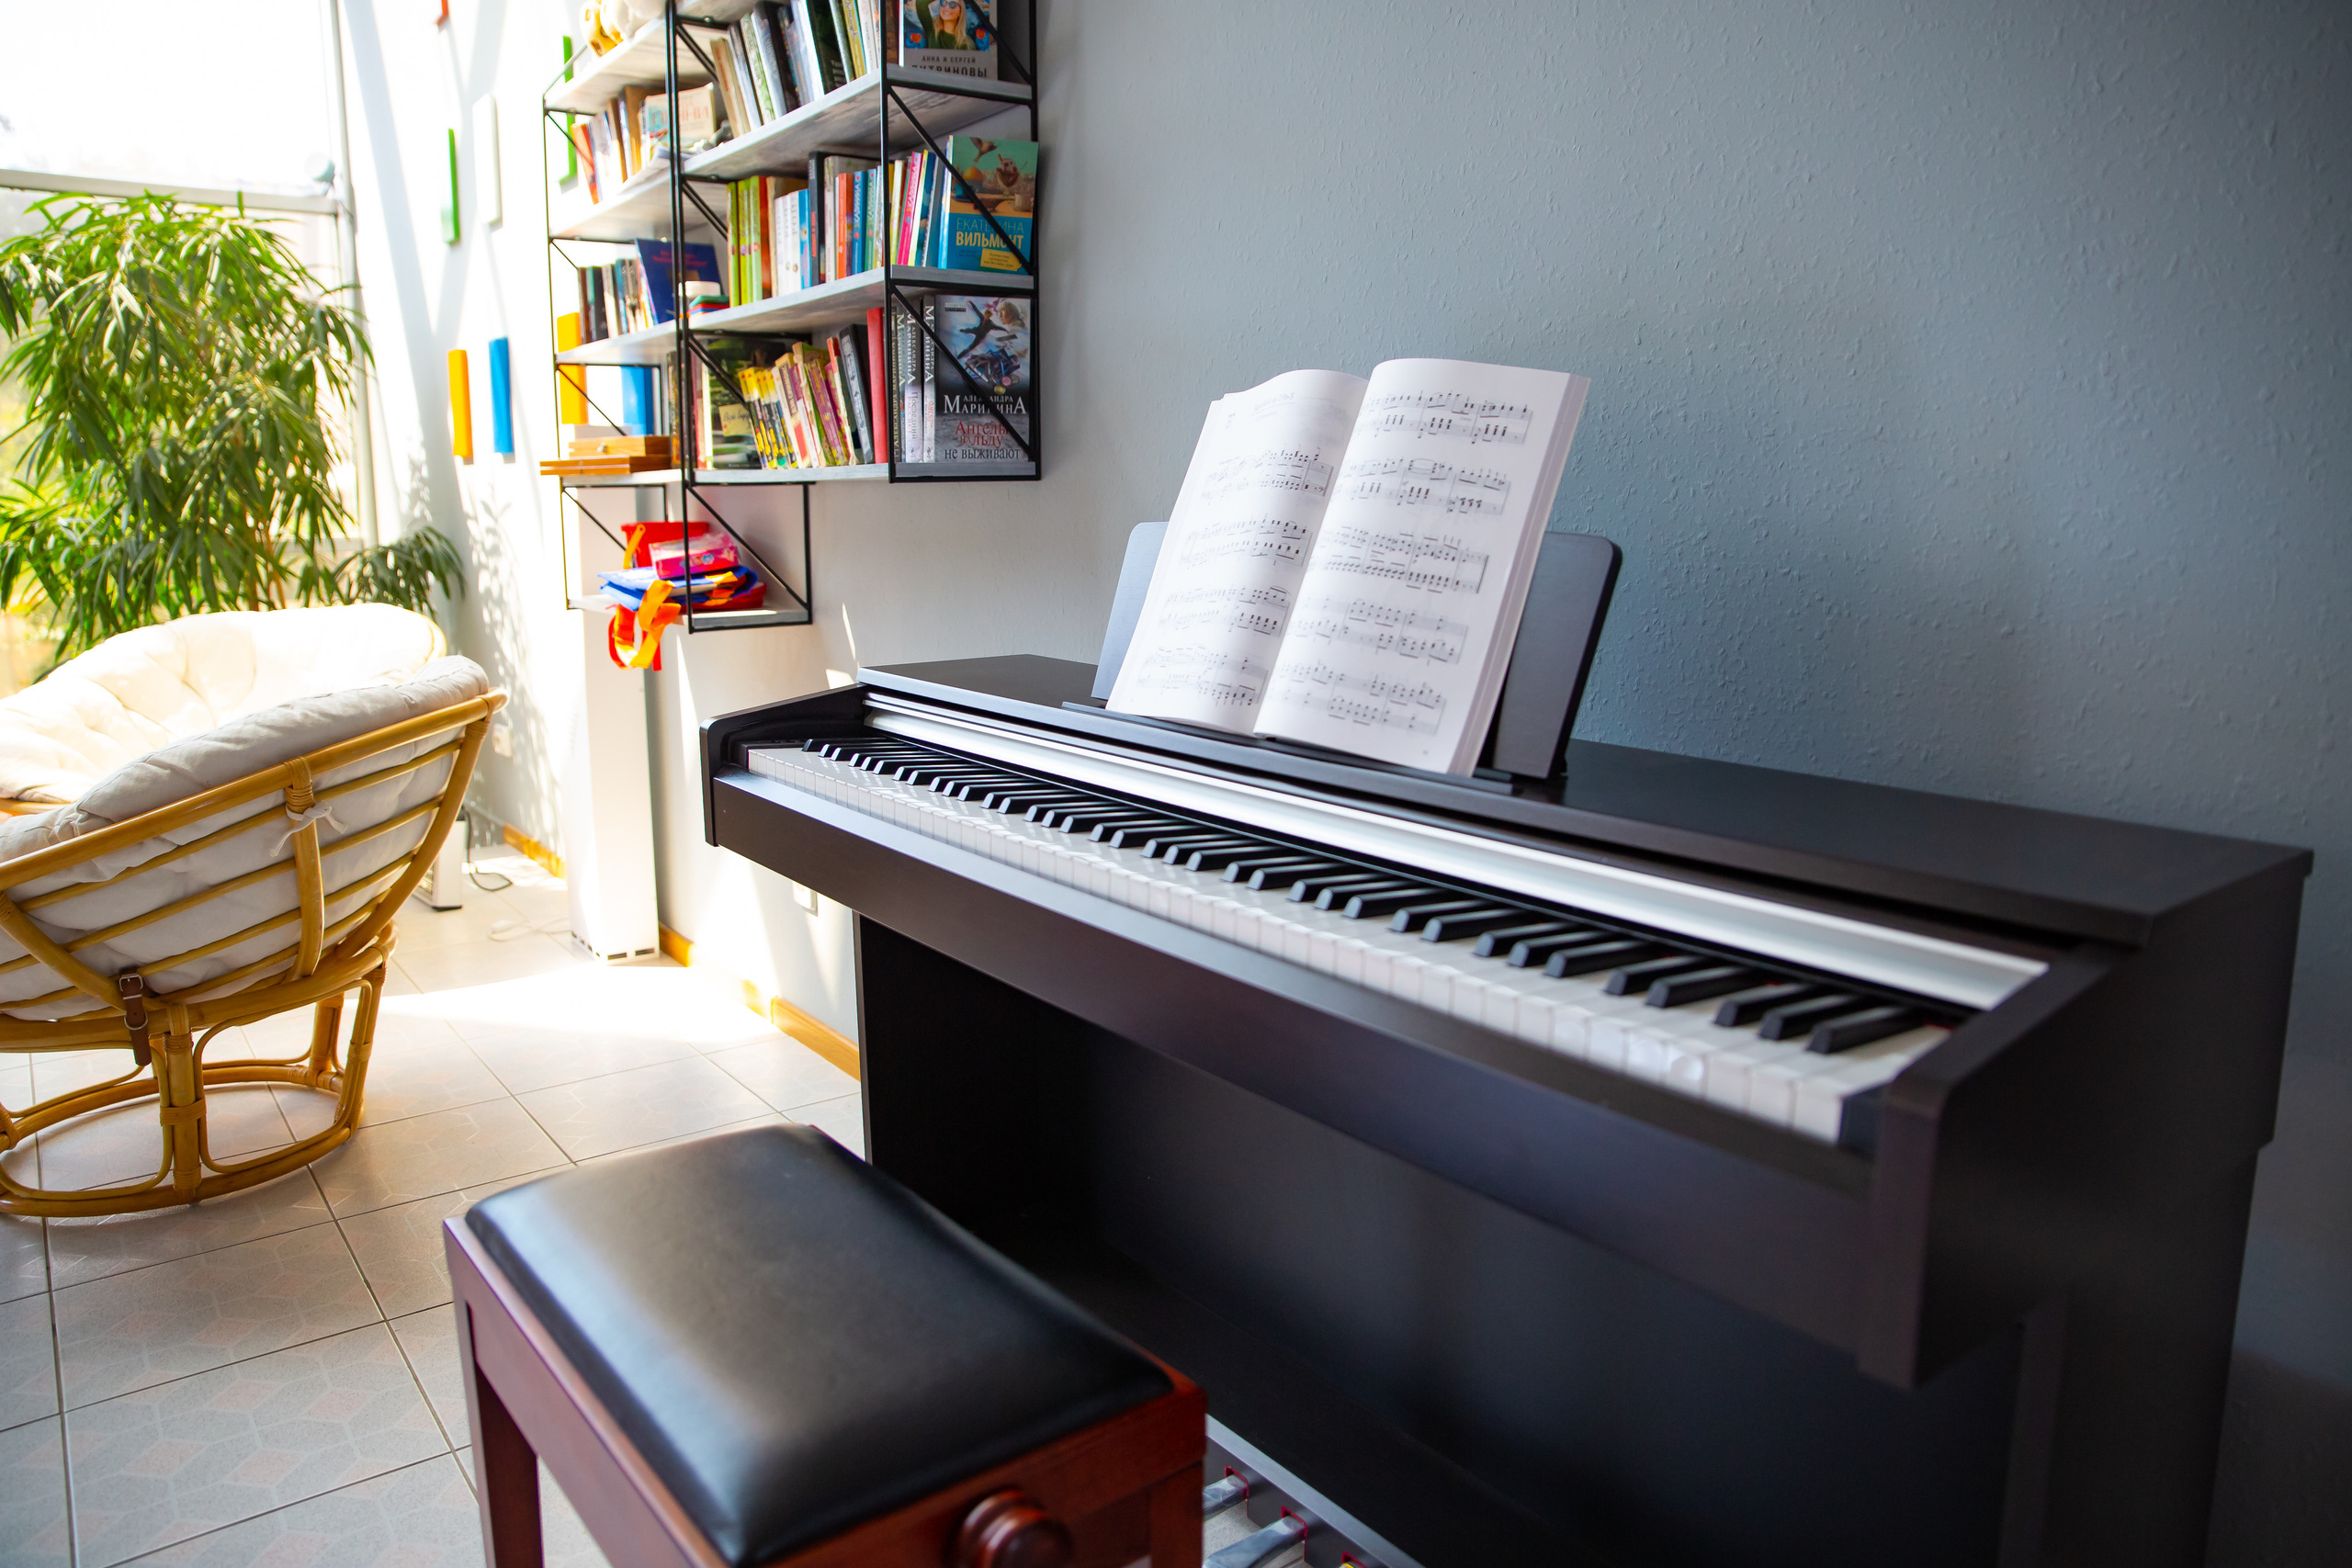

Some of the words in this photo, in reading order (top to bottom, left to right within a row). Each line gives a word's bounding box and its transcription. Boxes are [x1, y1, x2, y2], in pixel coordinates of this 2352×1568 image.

[922, 55, 940, 63] АННА
[950, 55, 976, 64] СЕРГЕЙ
[911, 64, 987, 78] ВИНОВЫ
[956, 217, 1024, 234] ЕКАТЕИНА
[924, 305, 934, 382] МИНИНА
[944, 394, 1026, 413] МАРИИНА
[961, 448, 1021, 459] выживают
